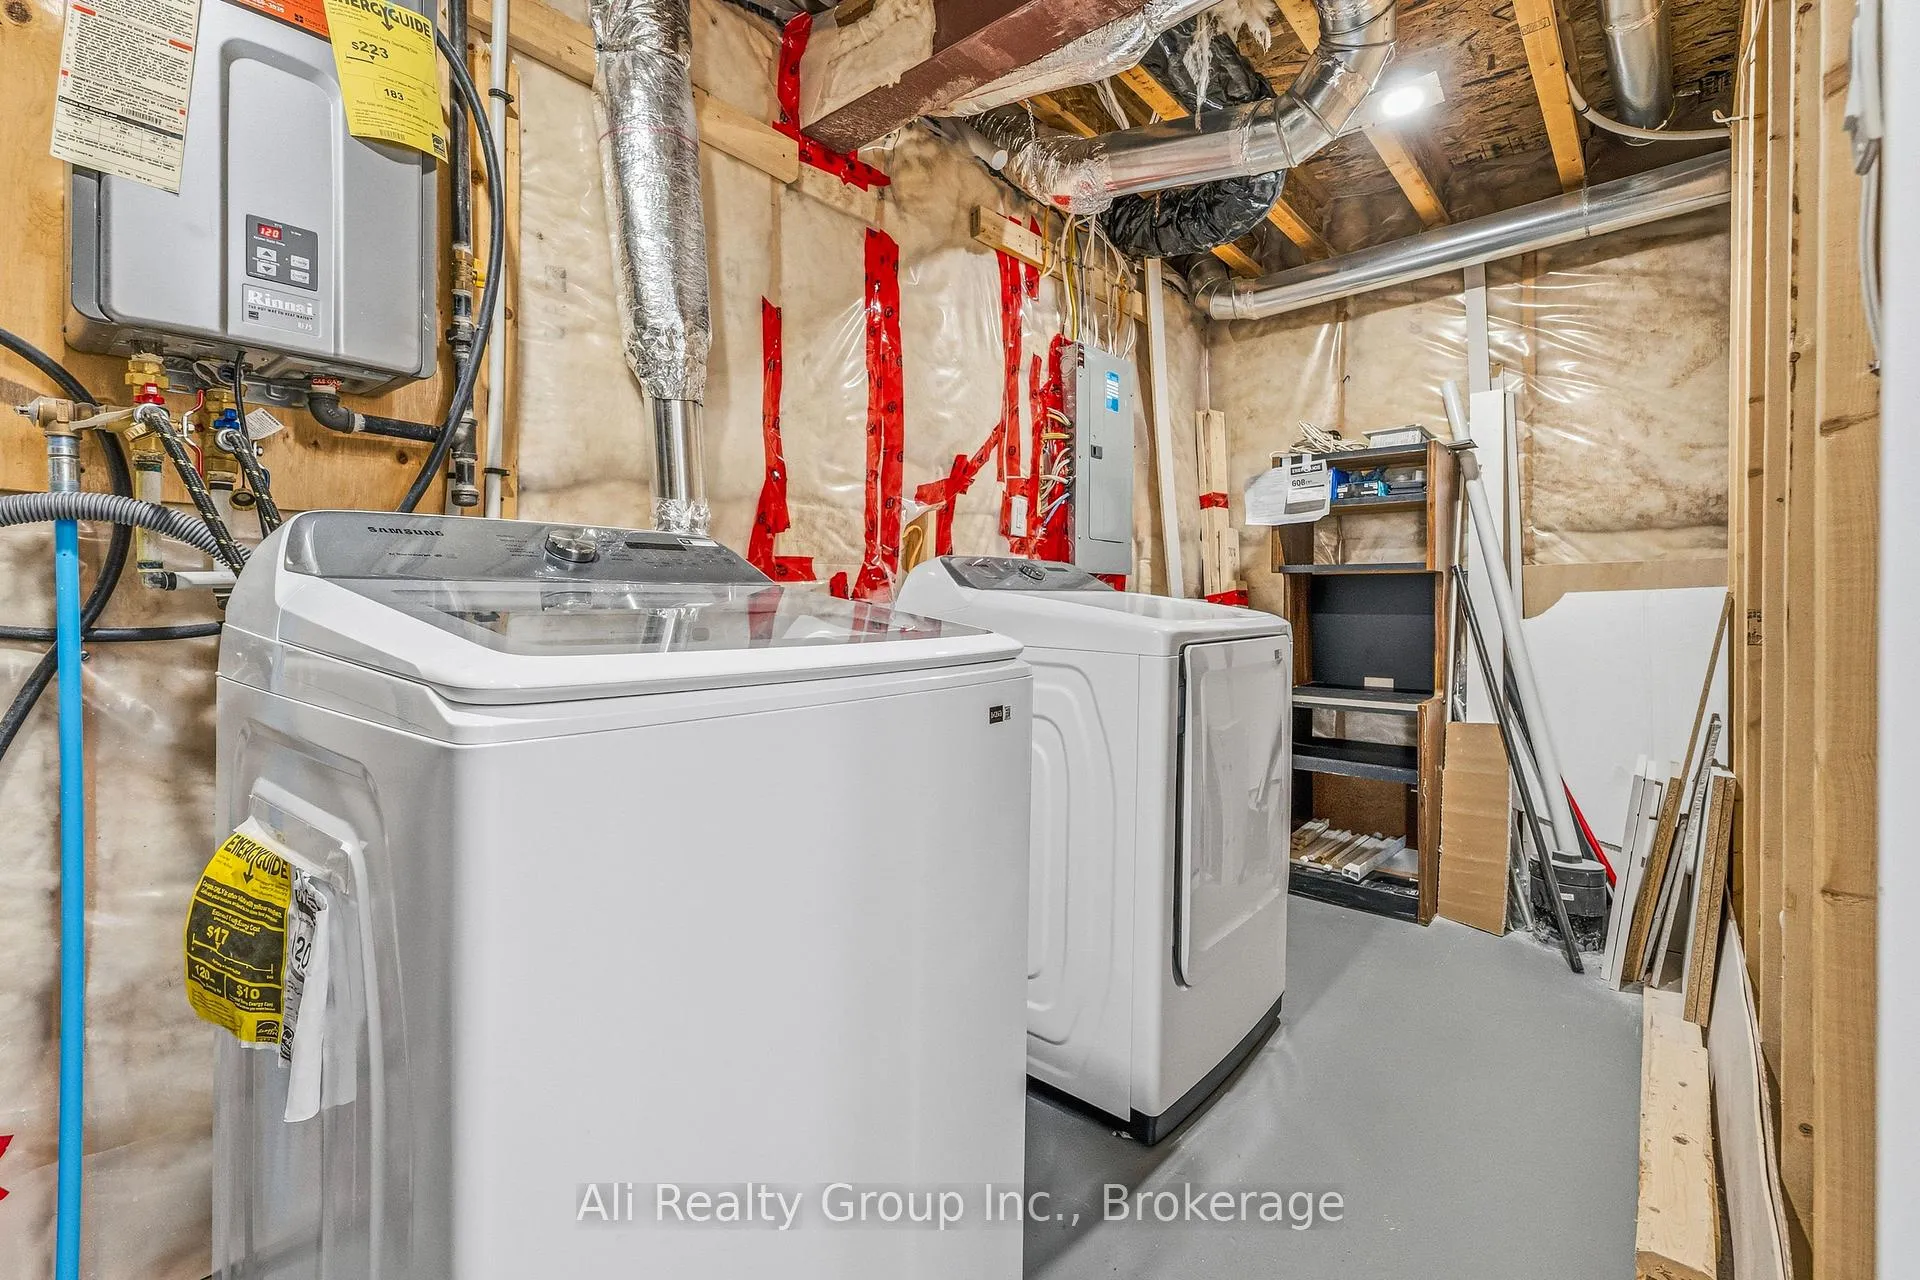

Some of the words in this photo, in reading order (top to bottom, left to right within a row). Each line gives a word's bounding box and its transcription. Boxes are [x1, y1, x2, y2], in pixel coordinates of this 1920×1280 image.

[384, 88, 404, 101] 183
[260, 227, 279, 237] 120
[247, 289, 314, 316] Rinnai
[368, 526, 444, 537] SAMSUNG
[207, 925, 229, 945] $17
[236, 984, 260, 1000] $10
